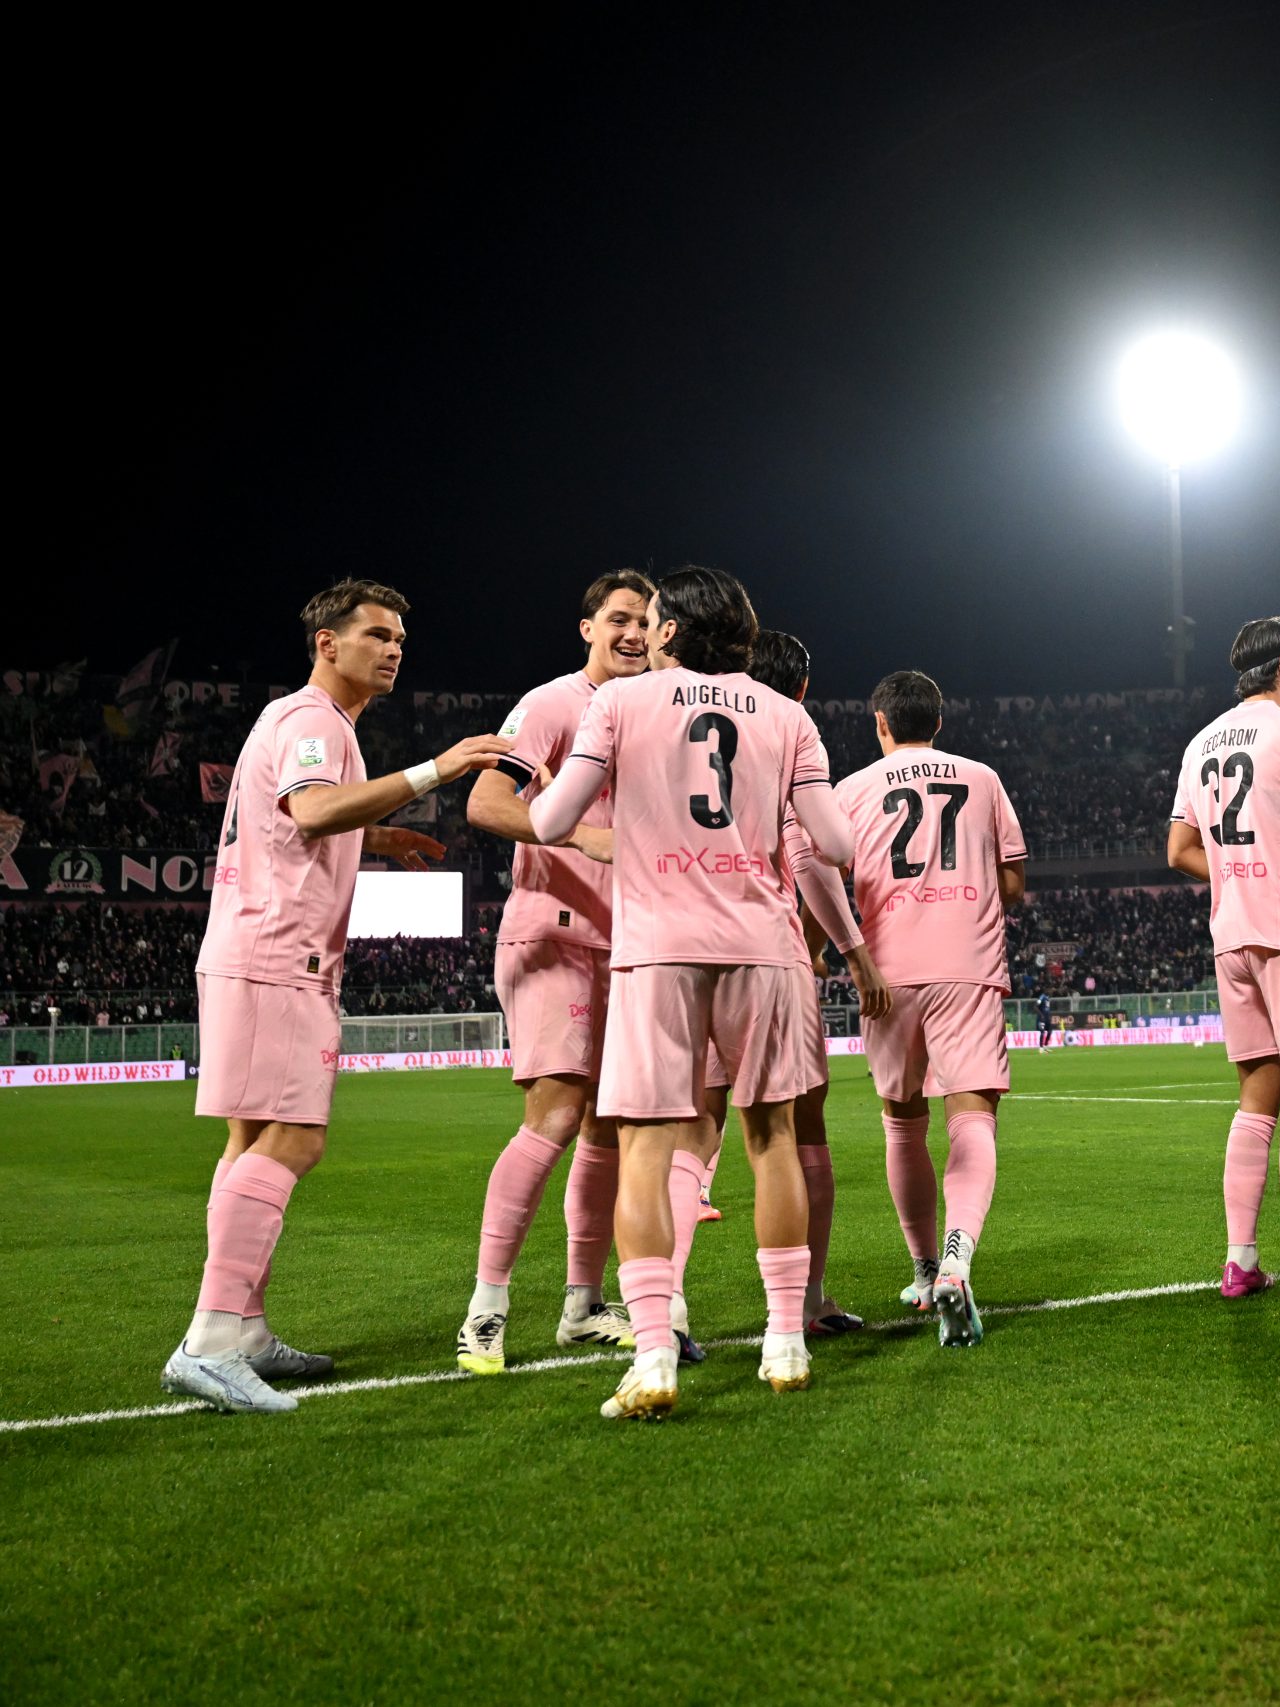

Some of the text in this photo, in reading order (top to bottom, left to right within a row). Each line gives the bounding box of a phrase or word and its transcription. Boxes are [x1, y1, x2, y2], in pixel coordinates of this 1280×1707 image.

[672, 684, 756, 714] AUGELLO
[689, 712, 739, 829] 3
[886, 763, 957, 785] PIEROZZI
[882, 782, 970, 880] 27
[63, 859, 89, 881] 12
[33, 1066, 71, 1083] OLD
[74, 1064, 121, 1082] WILD
[124, 1063, 174, 1081] WEST
